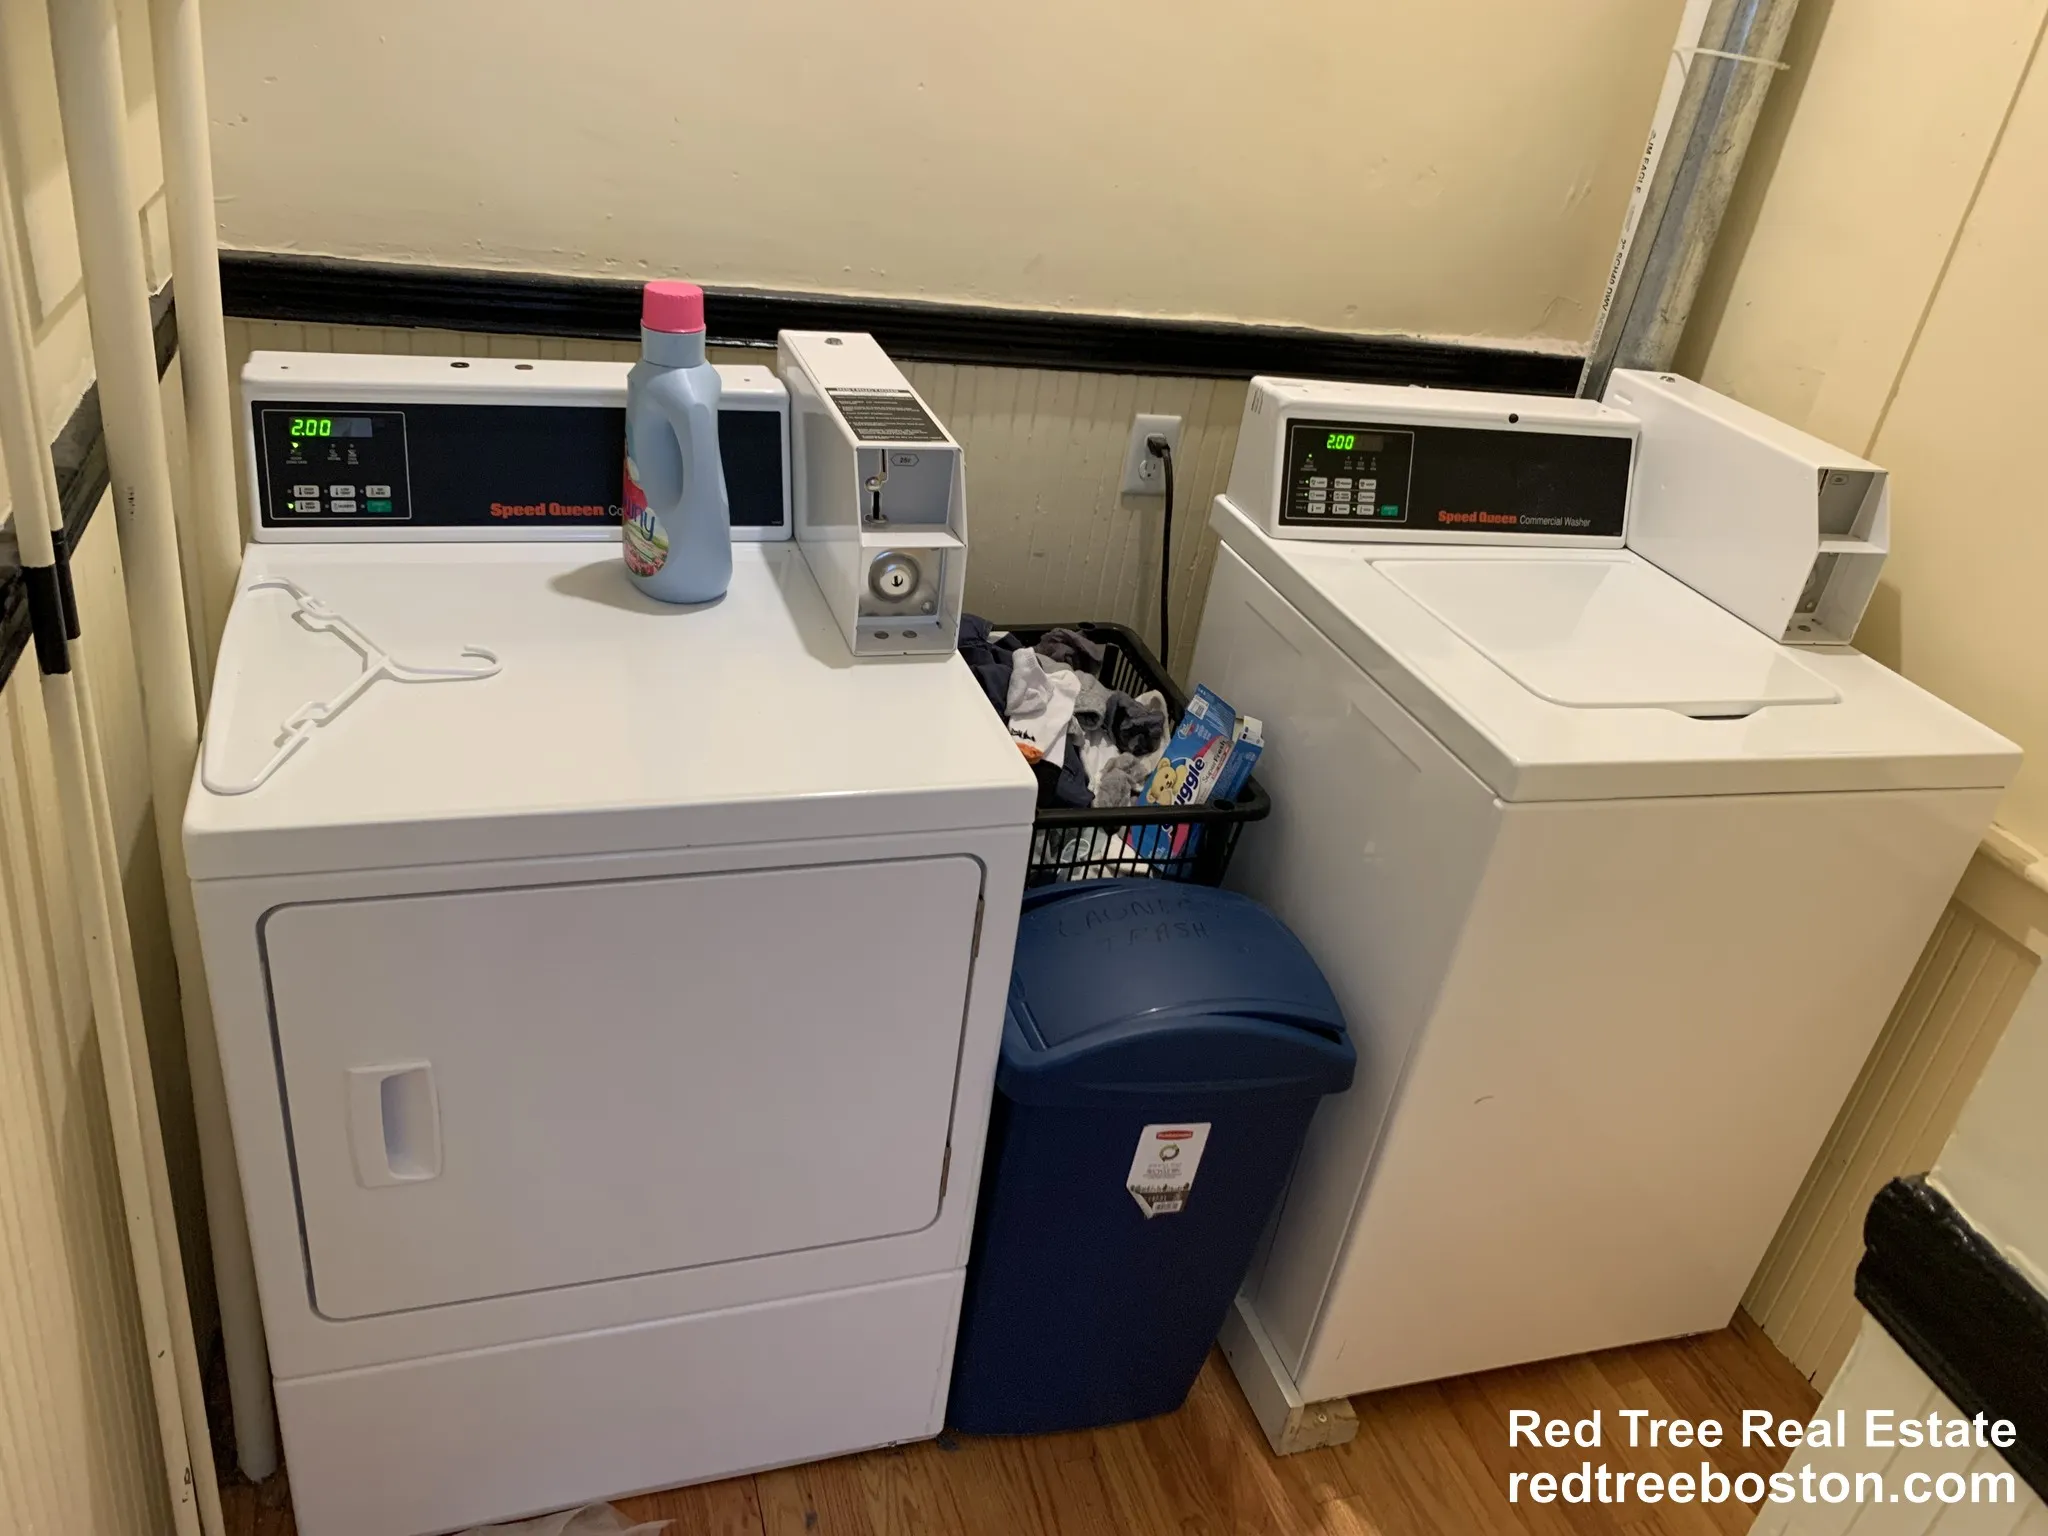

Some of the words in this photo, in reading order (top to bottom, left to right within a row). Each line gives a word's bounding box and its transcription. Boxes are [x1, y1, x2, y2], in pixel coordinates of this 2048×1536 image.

[291, 419, 331, 437] 2.00
[1326, 434, 1355, 450] 2.00
[490, 502, 546, 519] Speed
[549, 502, 604, 517] Queen
[608, 505, 623, 516] Co
[1438, 510, 1477, 524] Speed
[1479, 511, 1517, 524] Queen
[1519, 514, 1562, 526] Commercial
[1564, 516, 1591, 527] Washer
[1213, 740, 1227, 764] Fresh
[1174, 758, 1206, 806] uggle
